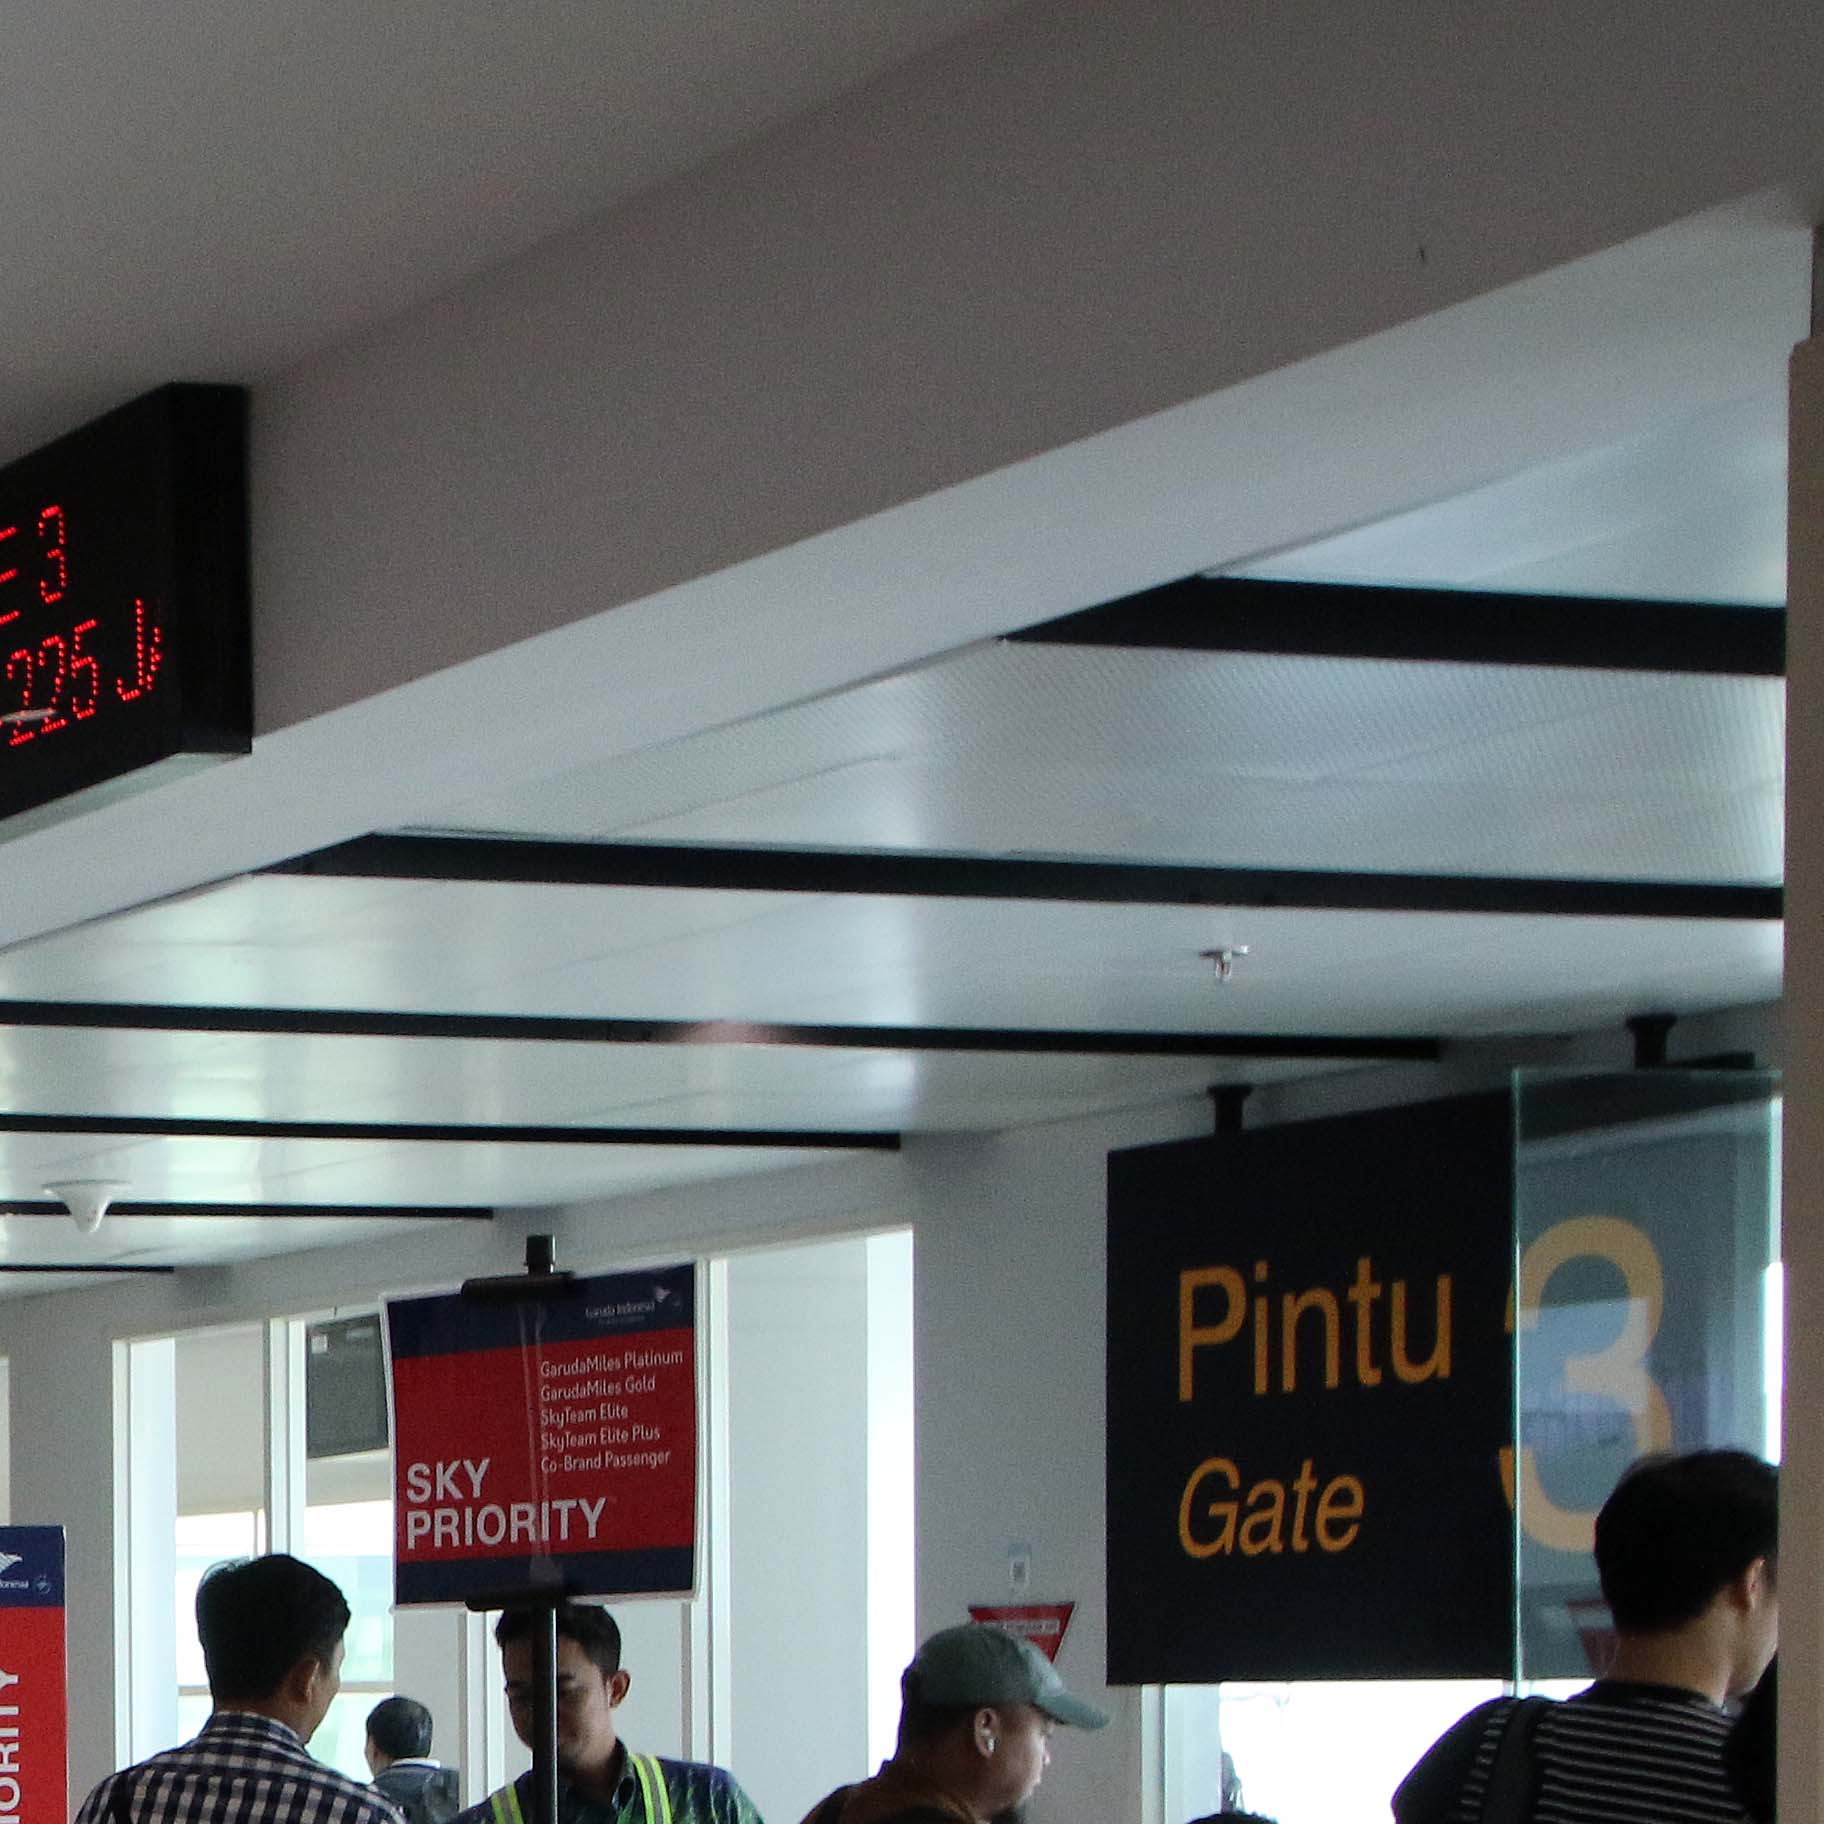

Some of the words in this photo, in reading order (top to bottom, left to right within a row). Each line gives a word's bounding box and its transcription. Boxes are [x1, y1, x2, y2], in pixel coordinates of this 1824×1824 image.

[38, 504, 66, 604] 3
[1177, 1256, 1453, 1402] Pintu
[540, 1353, 621, 1377] GarudaMiles
[624, 1350, 684, 1369] Platinum
[1499, 1215, 1673, 1554] 3
[540, 1378, 622, 1402] GarudaMiles
[625, 1375, 656, 1394] Gold
[540, 1406, 597, 1429] SkyTeam
[600, 1403, 629, 1421] Elite
[540, 1431, 597, 1453] SkyTeam
[600, 1427, 629, 1445] Elite
[632, 1424, 661, 1441] Plus
[406, 1458, 490, 1504] SKY
[541, 1453, 602, 1473] Co-Brand
[605, 1450, 672, 1469] Passenger
[406, 1497, 607, 1550] PRIORITY
[1177, 1455, 1366, 1560] Gate
